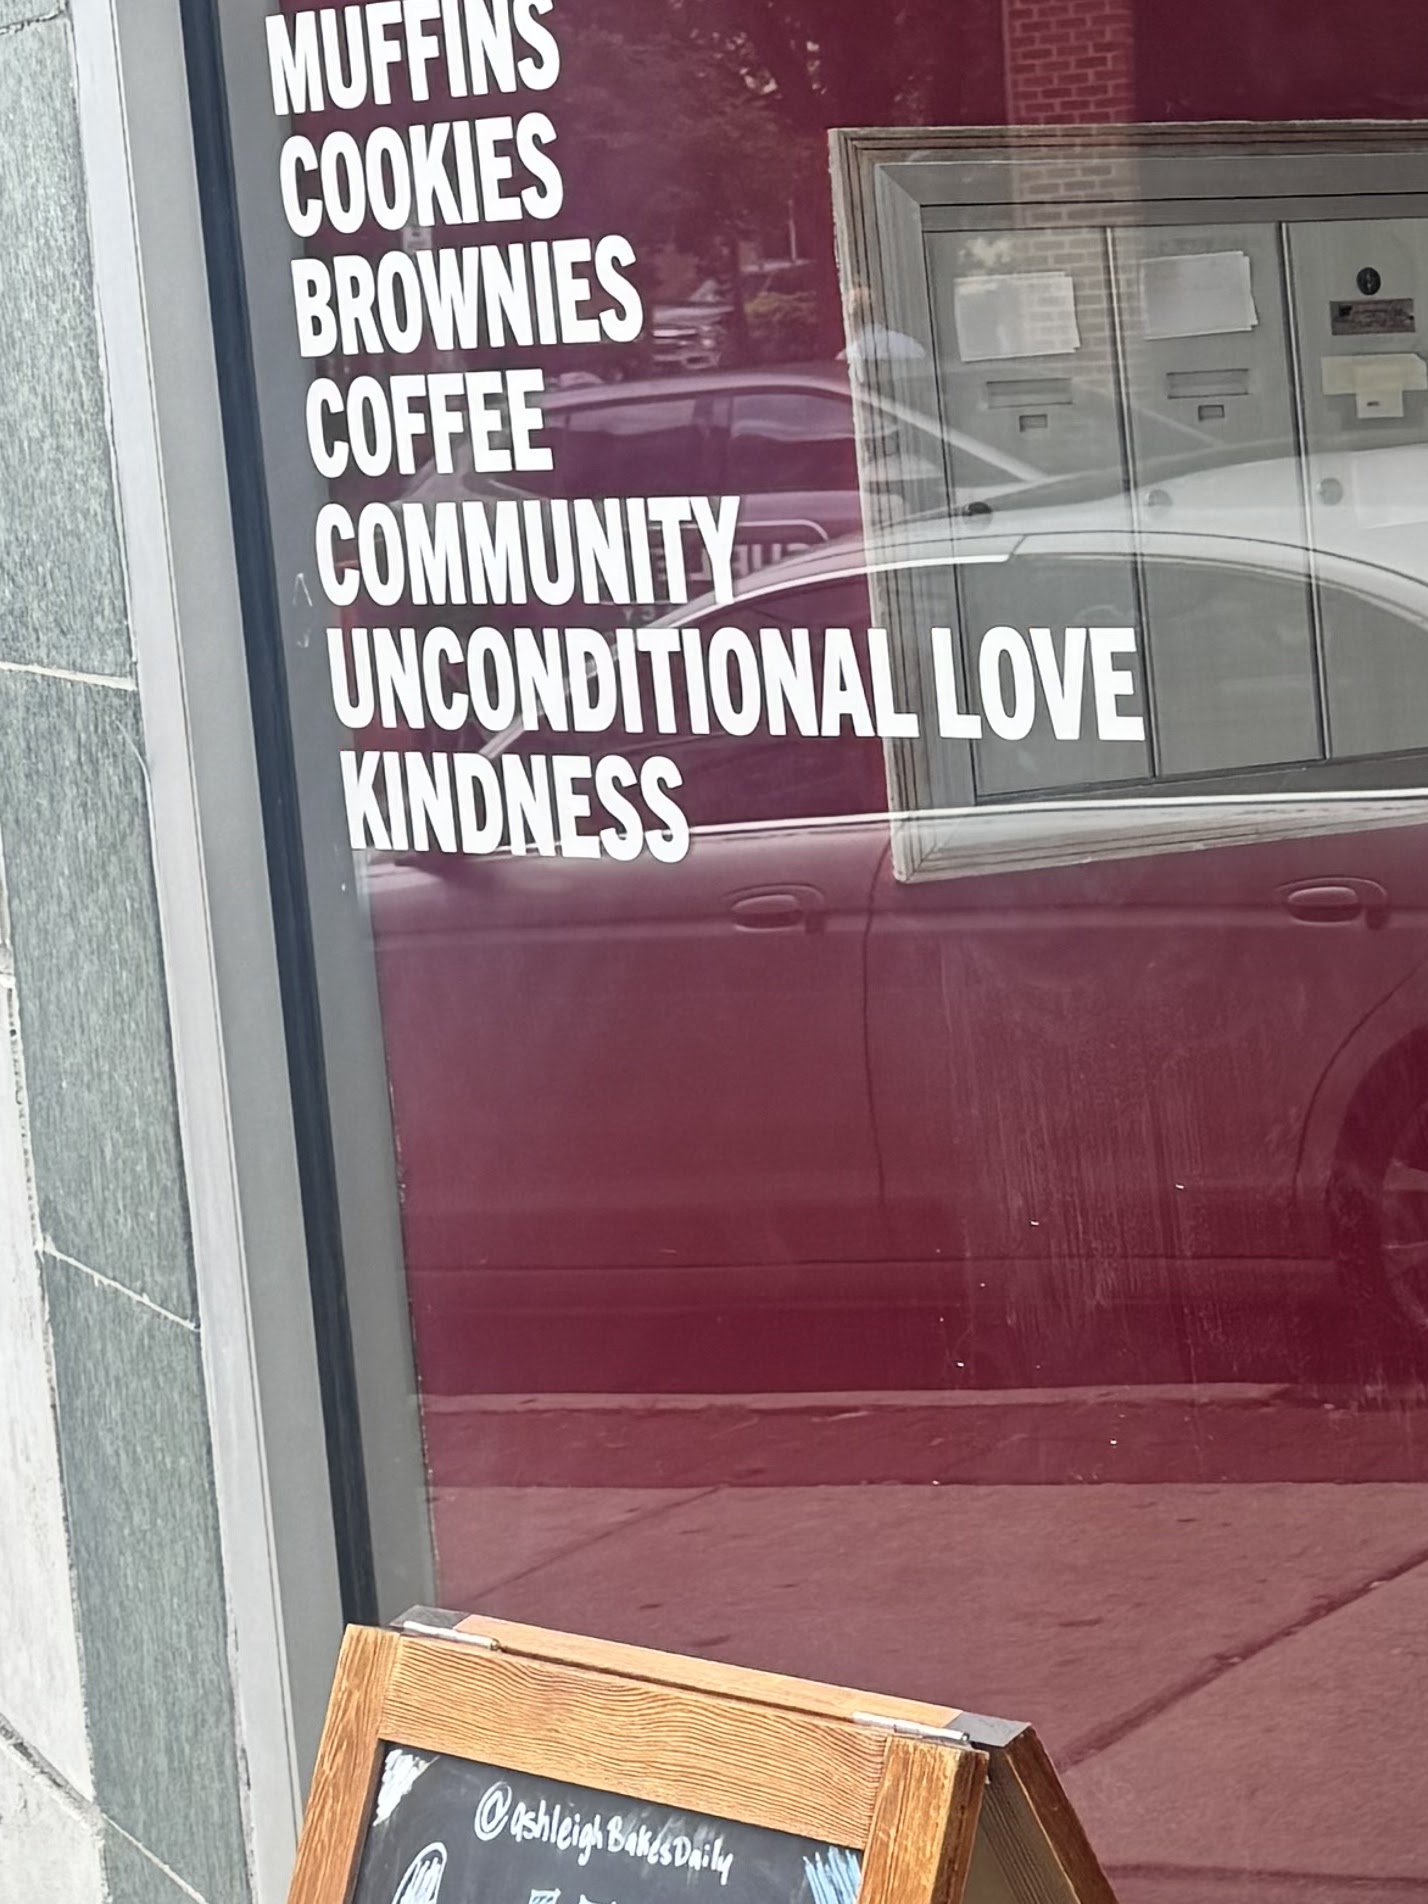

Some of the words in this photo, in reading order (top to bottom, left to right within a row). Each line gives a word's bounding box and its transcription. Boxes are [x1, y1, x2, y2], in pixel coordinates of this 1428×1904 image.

[279, 112, 564, 238] COOKIES
[290, 234, 644, 359] BROWNIES
[305, 368, 555, 479] COFFEE
[314, 496, 741, 607] COMMUNITY
[326, 626, 919, 739] UNCONDITIONAL
[930, 626, 1146, 743] LOVE
[338, 749, 691, 864] KINDNESS
